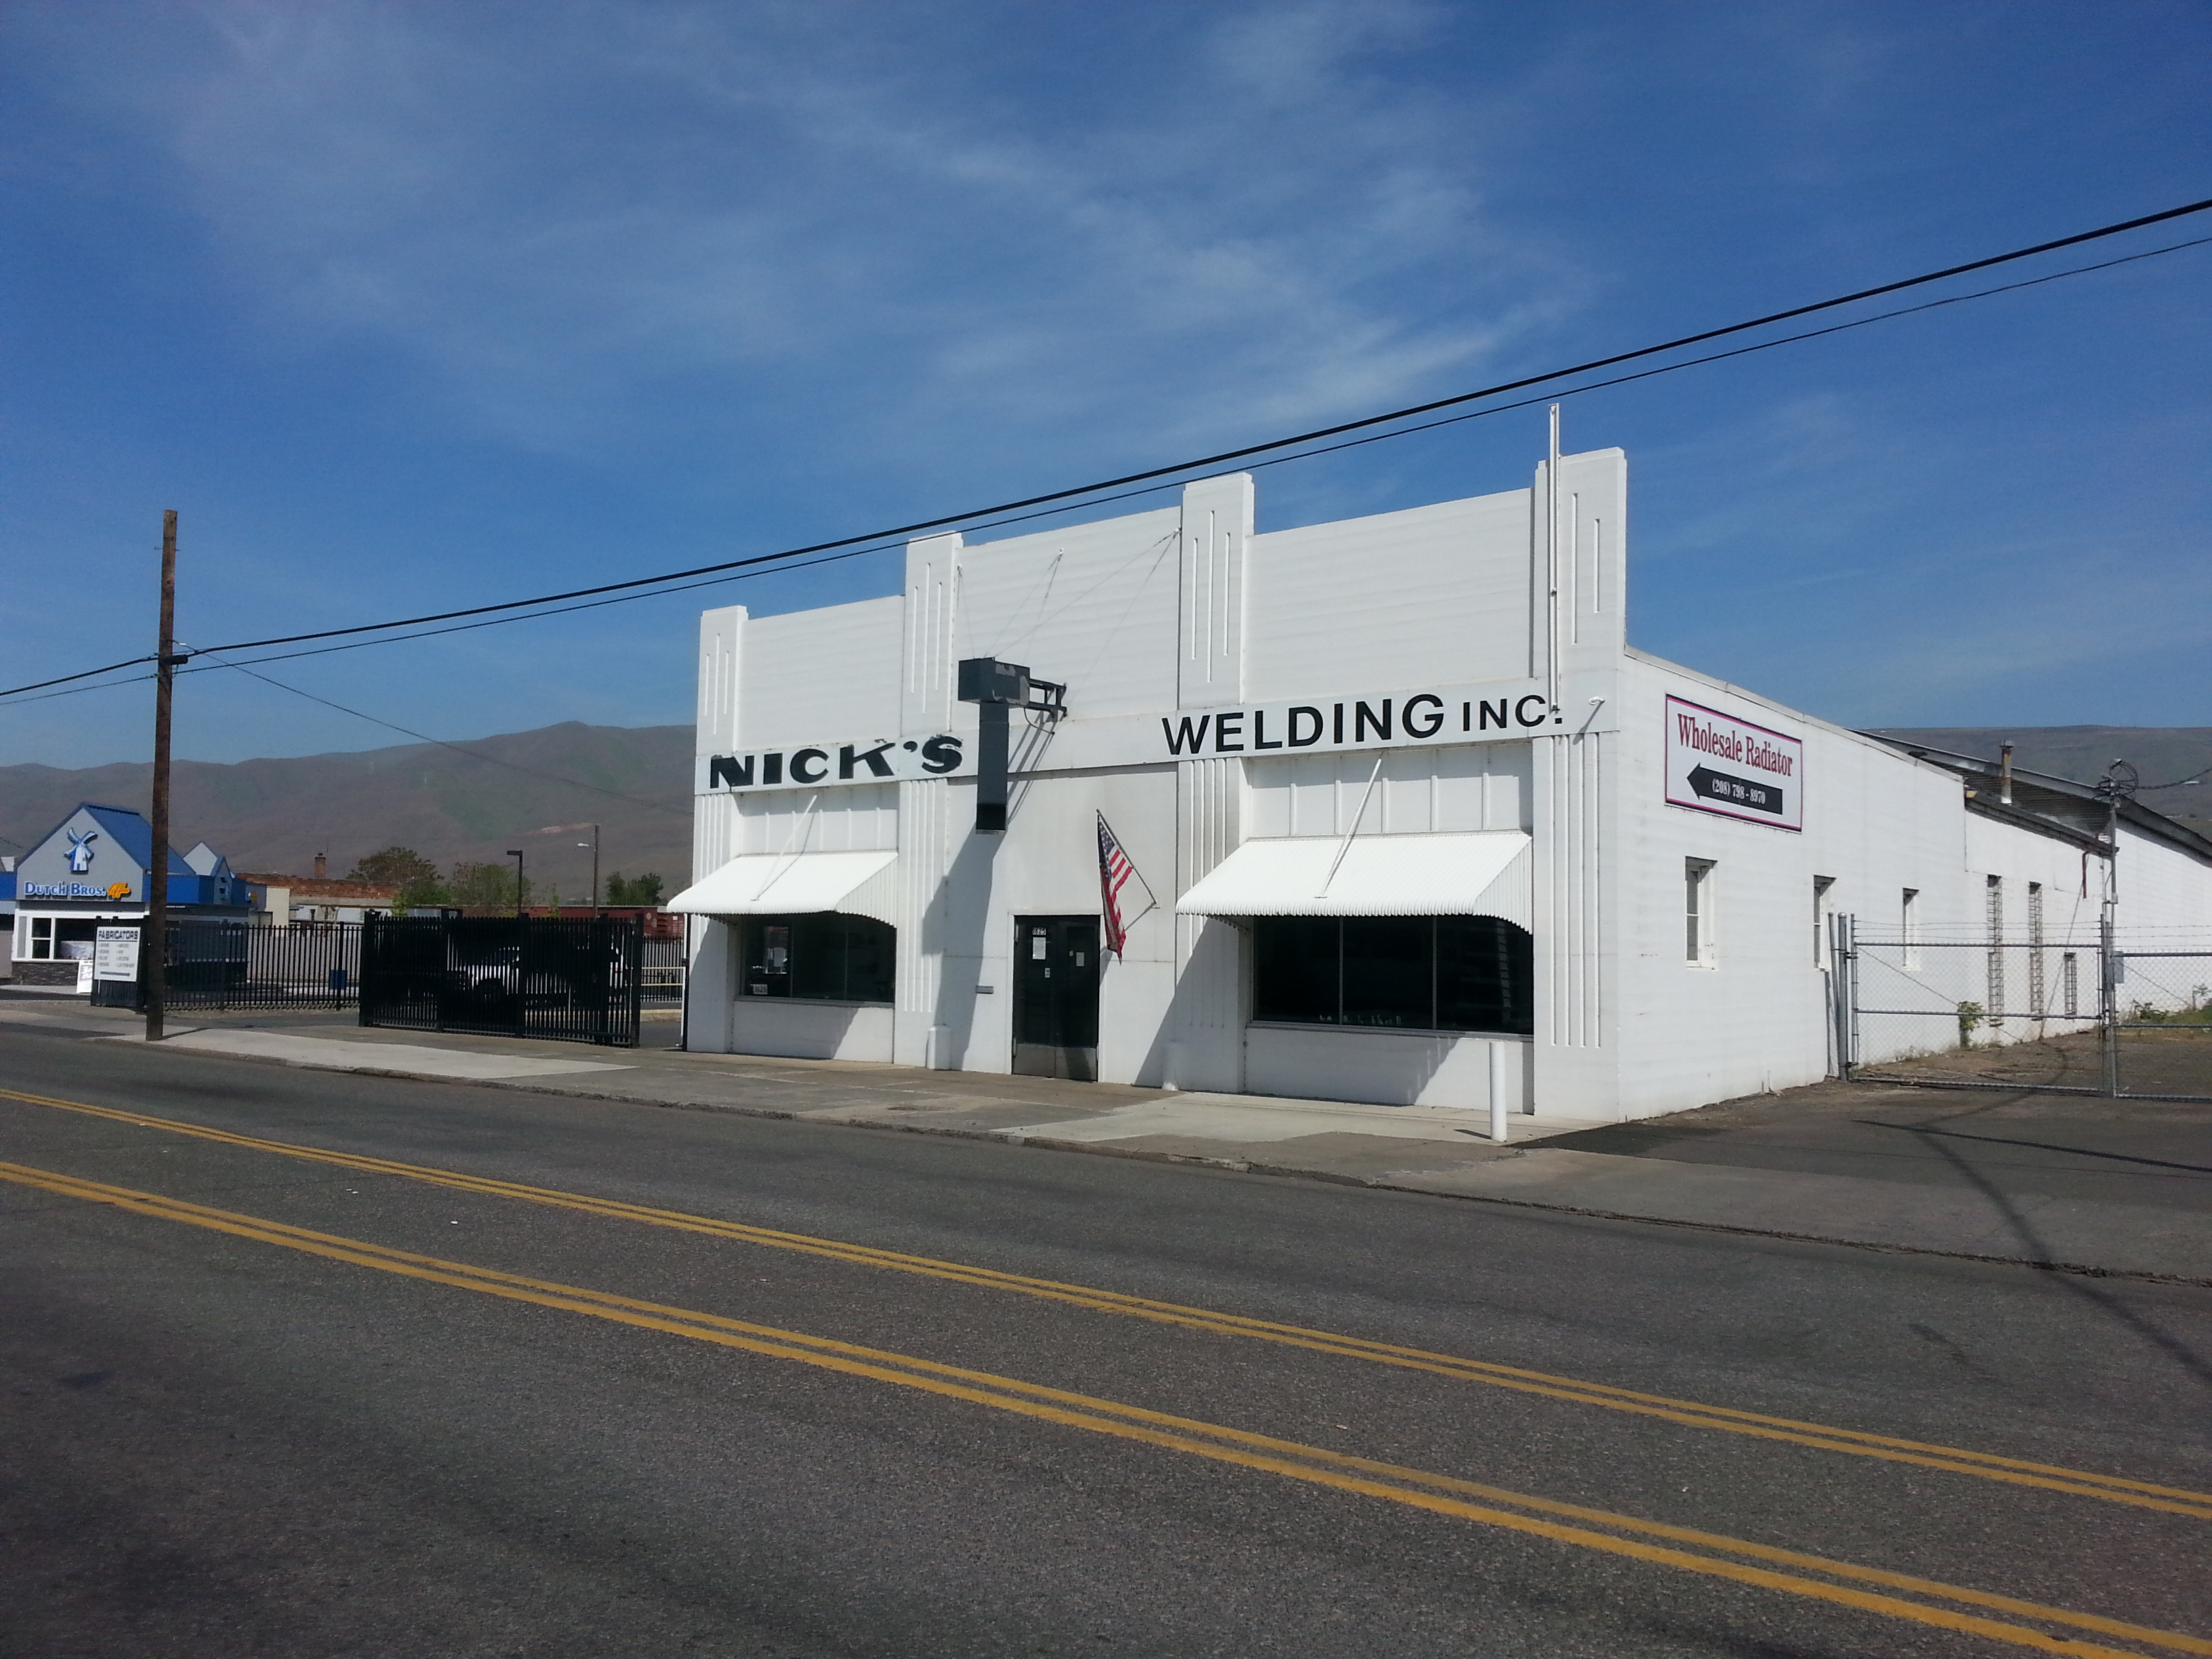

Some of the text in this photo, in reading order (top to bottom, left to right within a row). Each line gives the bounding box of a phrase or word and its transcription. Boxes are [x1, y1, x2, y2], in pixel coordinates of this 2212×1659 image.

[710, 693, 1563, 789] NICK'S WELDING INC.
[1677, 713, 1793, 777] Wholesale Radiator
[1712, 778, 1730, 796] (208)
[1732, 783, 1744, 800] 798
[1750, 789, 1766, 804] 8970
[98, 930, 138, 940] FABRICATORS
